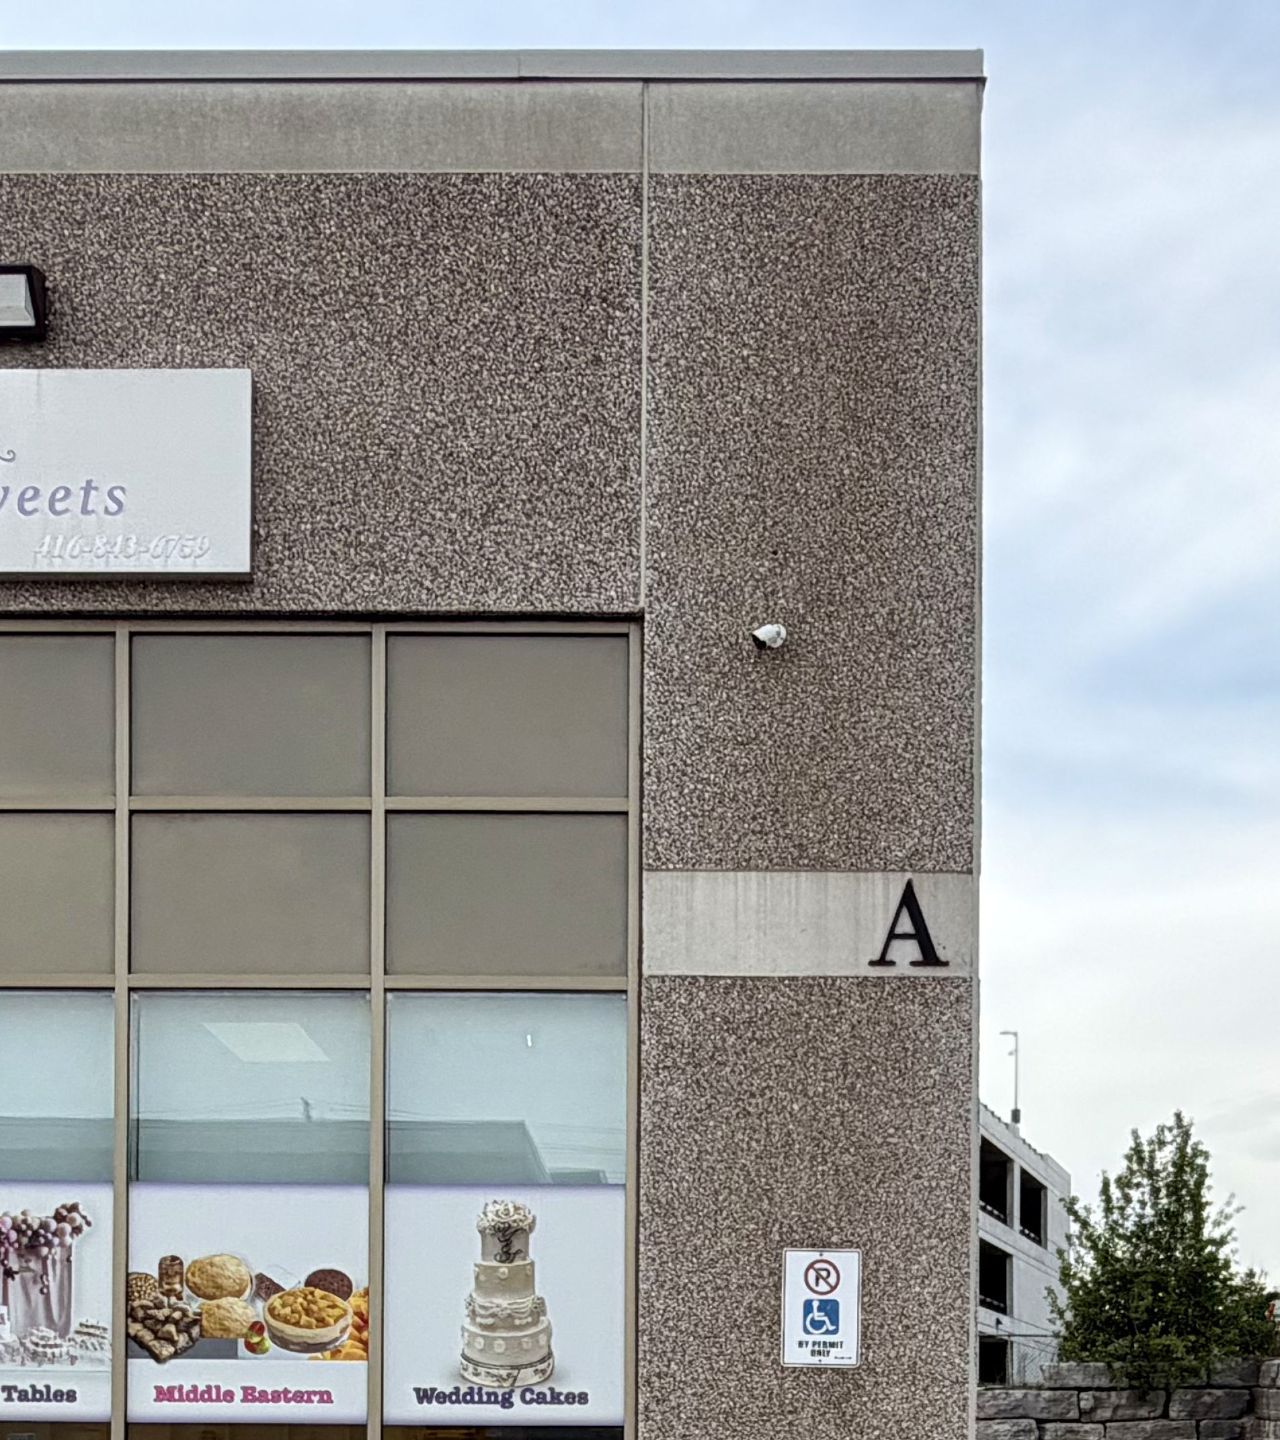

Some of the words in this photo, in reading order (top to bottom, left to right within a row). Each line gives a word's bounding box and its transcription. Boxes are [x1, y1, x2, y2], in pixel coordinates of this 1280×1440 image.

[868, 878, 950, 967] A
[1, 1383, 77, 1403] Tables
[153, 1384, 234, 1404] Middle
[240, 1385, 334, 1405] Eastern
[413, 1387, 515, 1409] Wedding
[520, 1387, 589, 1406] Cakes
